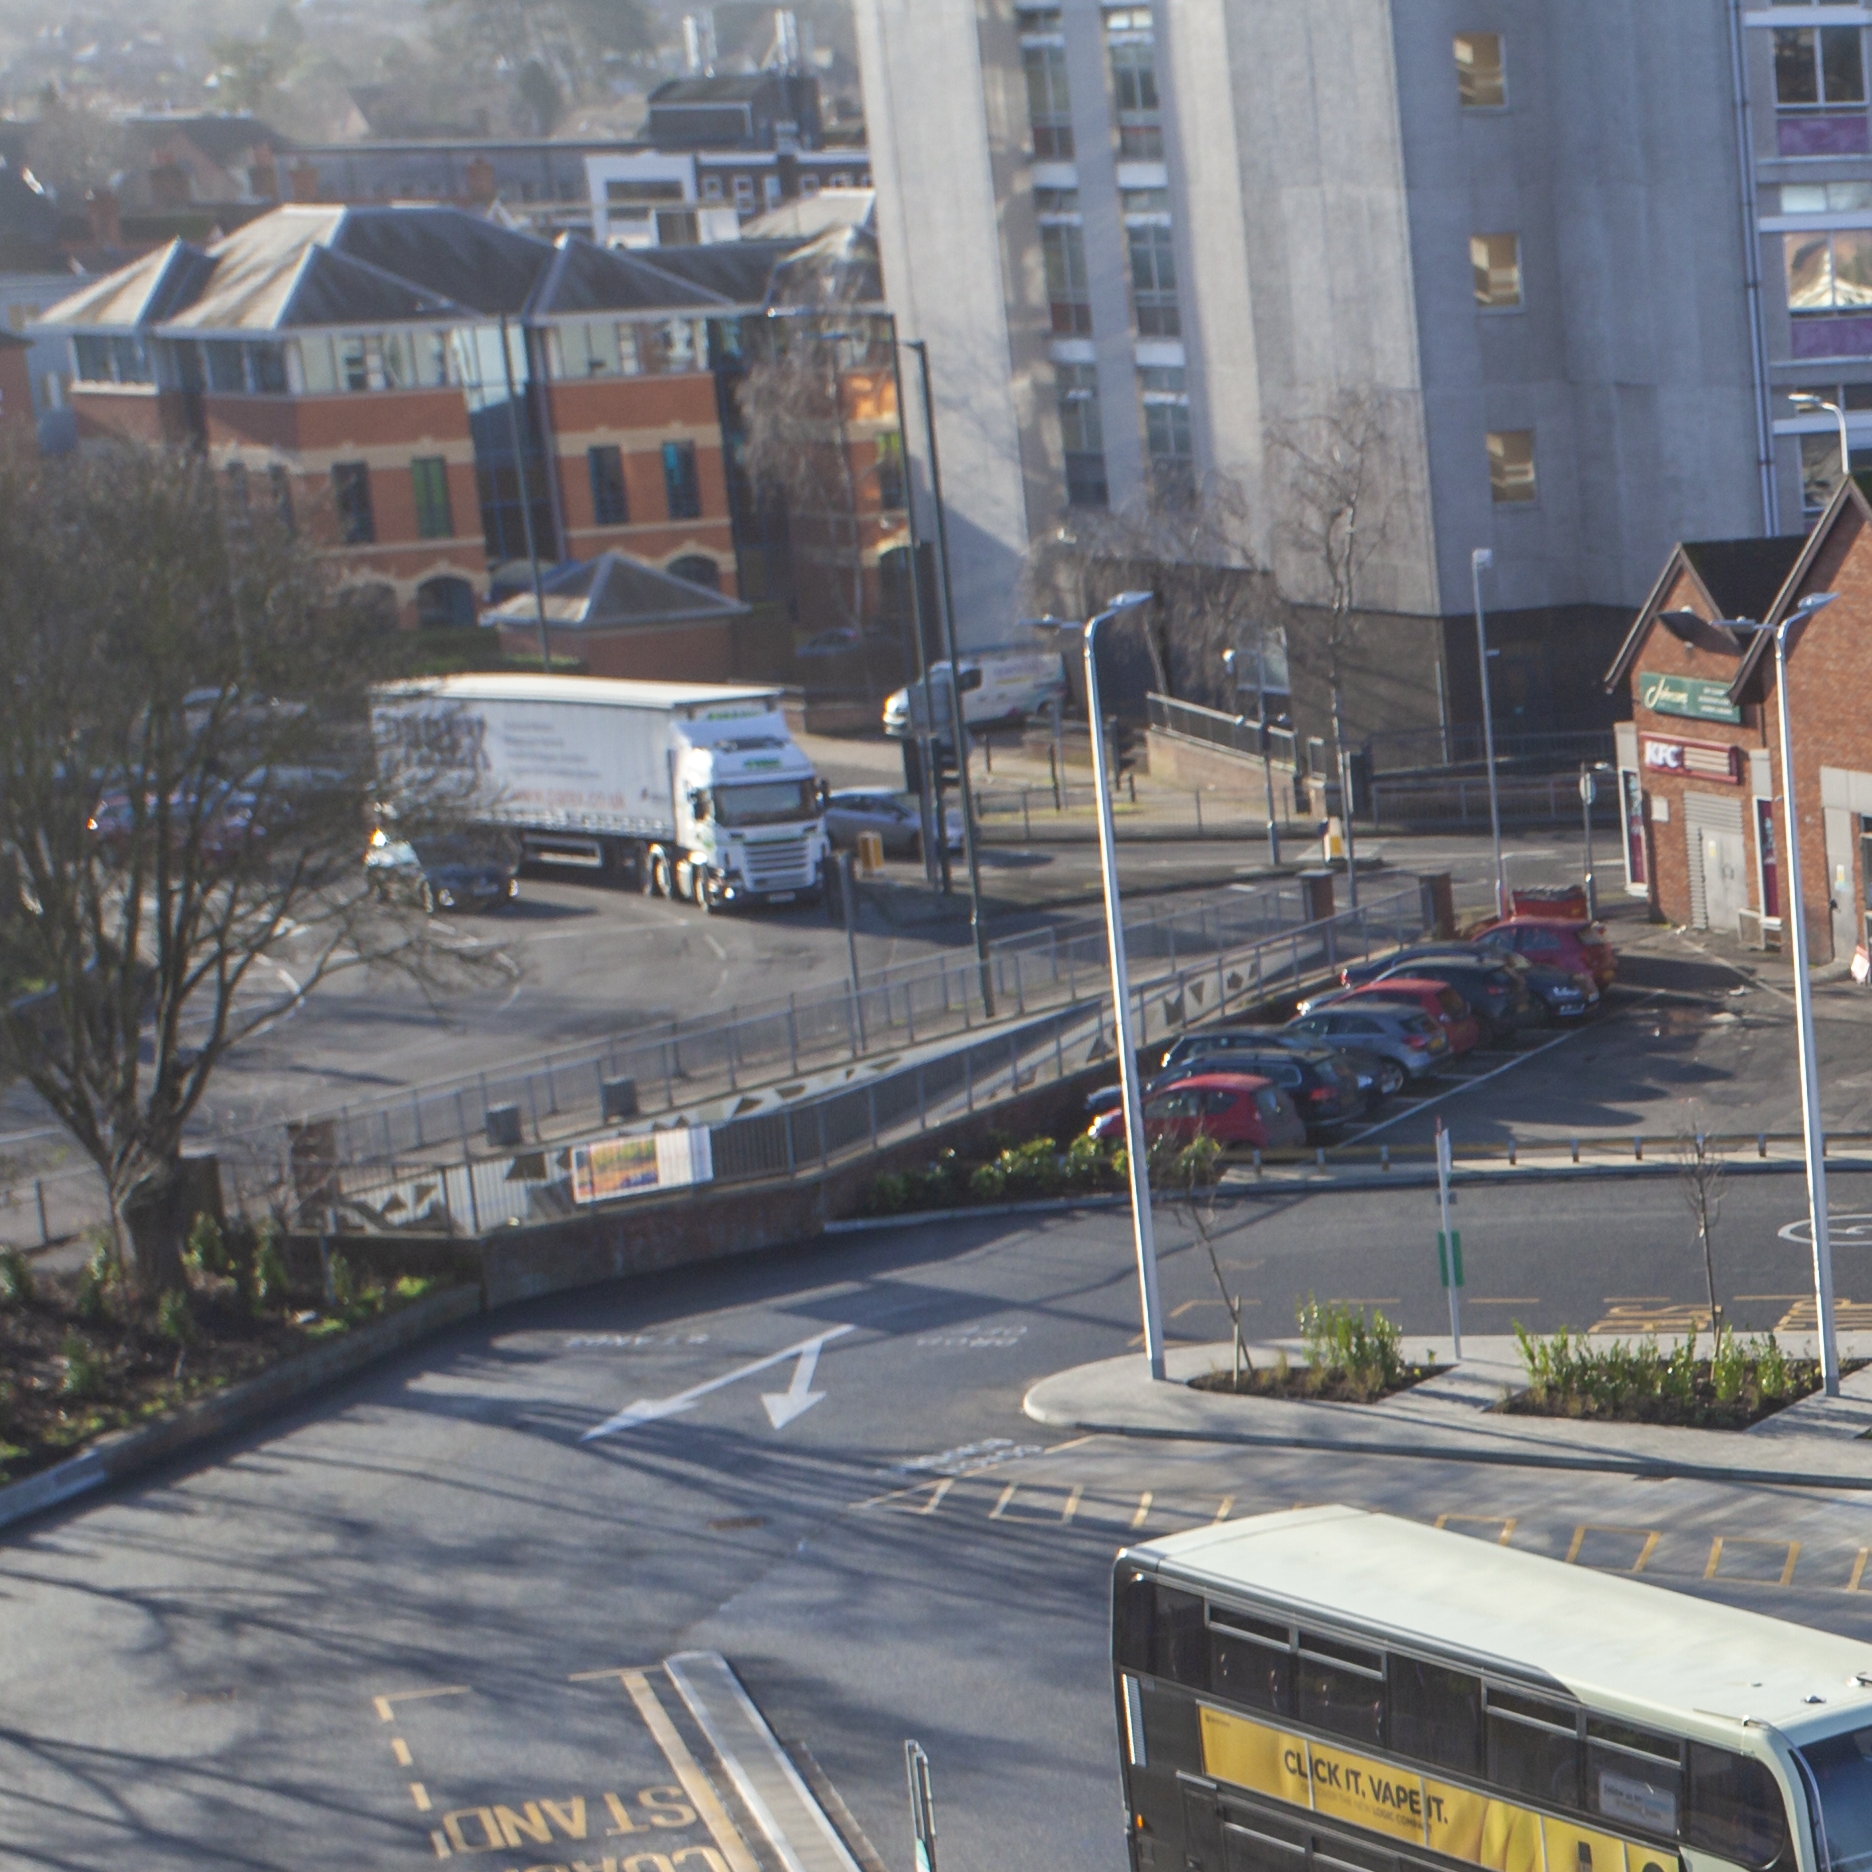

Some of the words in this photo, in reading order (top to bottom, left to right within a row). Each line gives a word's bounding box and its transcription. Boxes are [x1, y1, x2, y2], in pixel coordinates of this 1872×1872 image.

[1645, 740, 1682, 769] KFC
[1284, 1748, 1342, 1789] CLICK
[1344, 1767, 1367, 1799] IT.
[1369, 1774, 1423, 1816] VAPE
[443, 1782, 698, 1856] STAND
